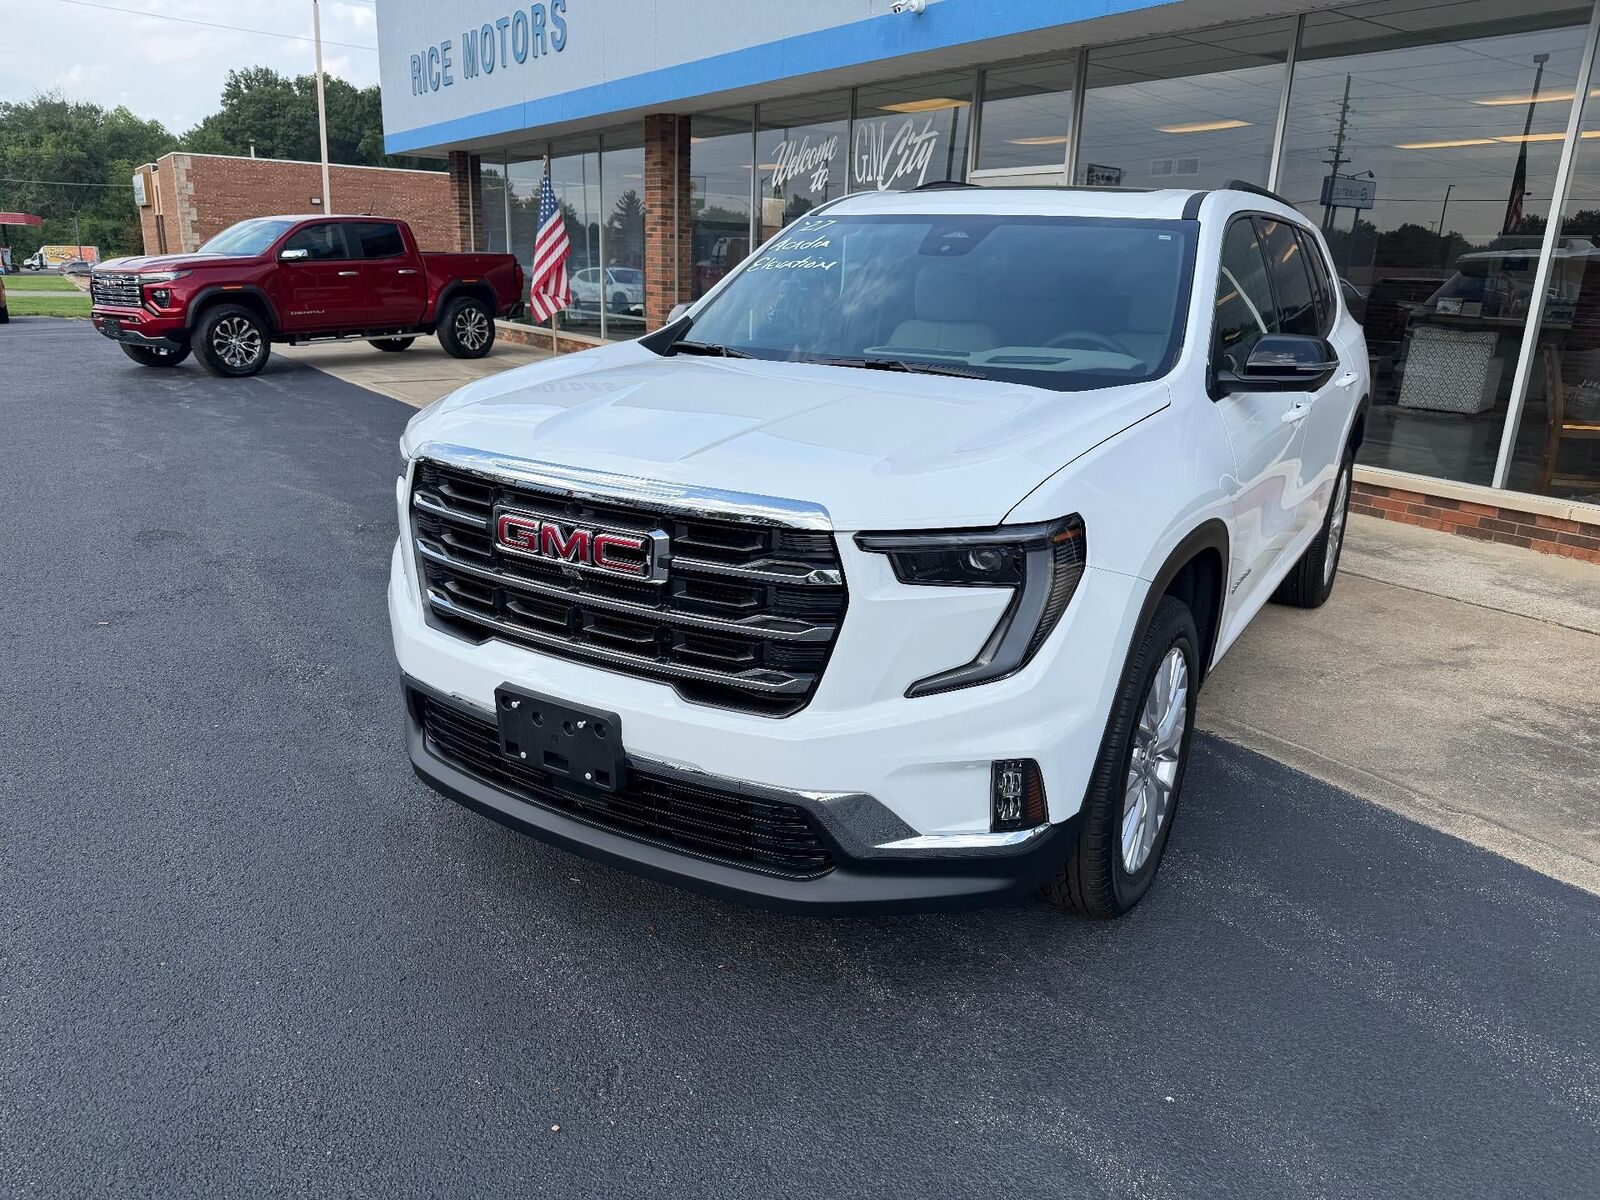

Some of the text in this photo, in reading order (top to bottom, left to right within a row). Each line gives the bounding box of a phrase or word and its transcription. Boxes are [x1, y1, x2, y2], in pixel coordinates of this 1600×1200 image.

[410, 0, 567, 96] RICE MOTORS
[771, 135, 838, 188] Welcome
[809, 160, 829, 193] to
[855, 117, 940, 191] GM City
[498, 514, 645, 576] GMC
